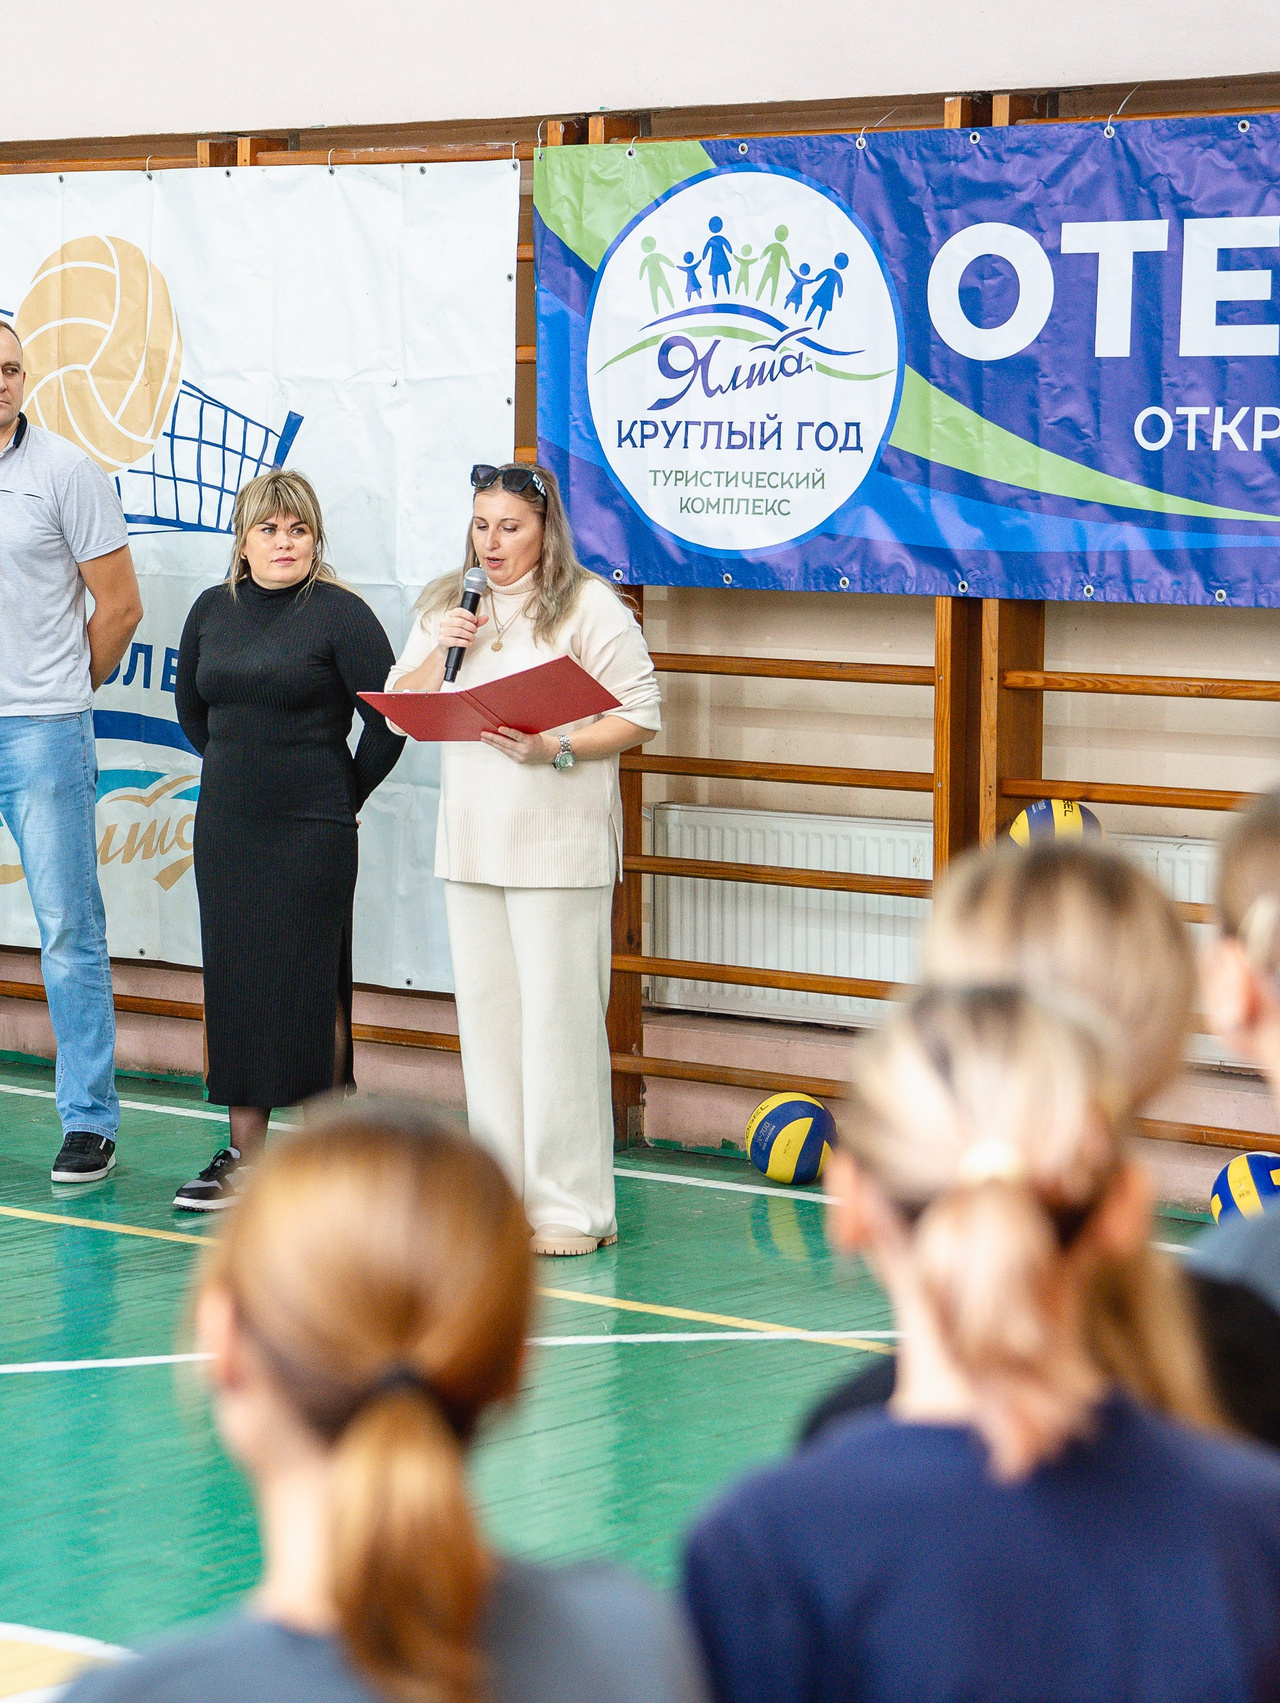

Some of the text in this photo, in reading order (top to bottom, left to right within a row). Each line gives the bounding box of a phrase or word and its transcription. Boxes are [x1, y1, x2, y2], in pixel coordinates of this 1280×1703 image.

[927, 216, 1280, 361] ОТЕ
[647, 335, 813, 411] Ялта
[617, 414, 863, 453] КРУГЛЫЙ ГОД
[1134, 406, 1280, 451] ОТКР
[649, 468, 825, 490] ТУРИСТИЧЕСКИЙ
[679, 497, 791, 516] КОМПЛЕКС
